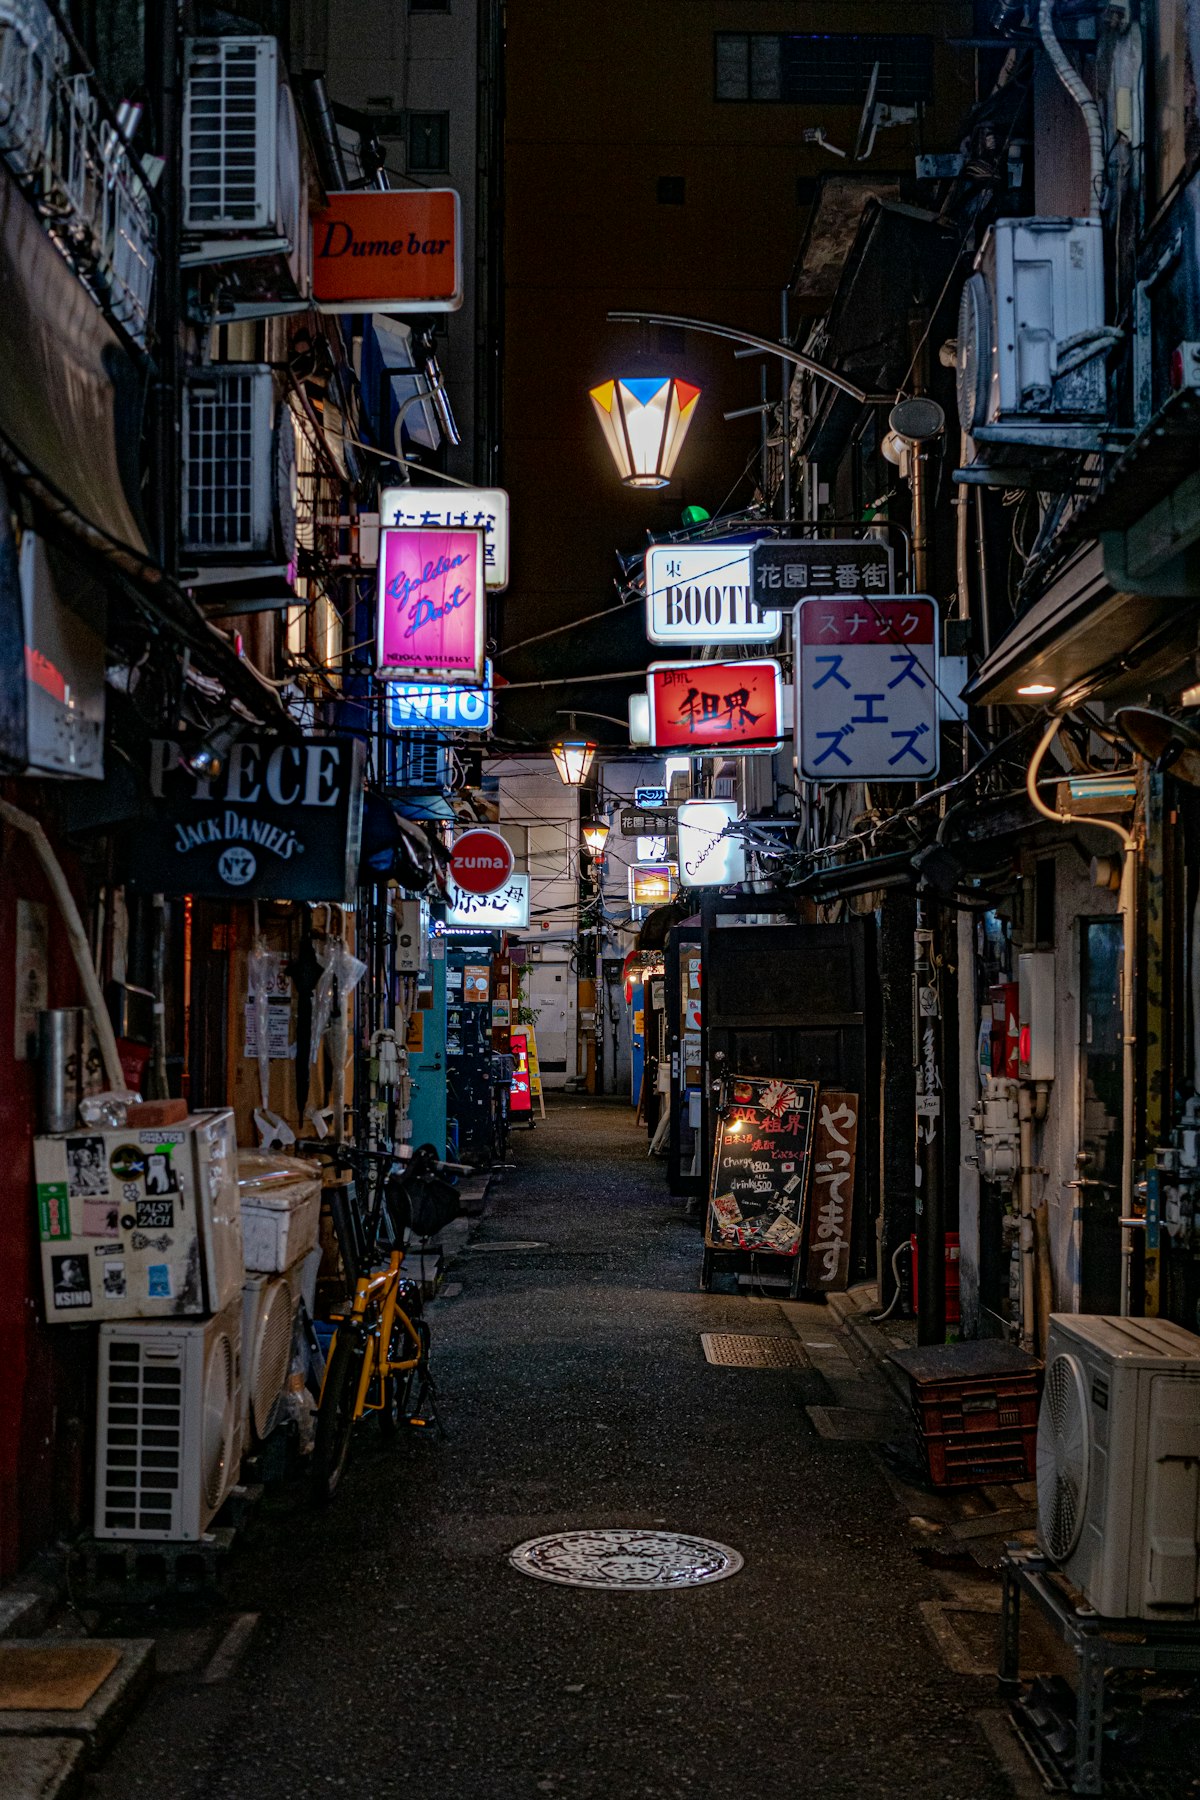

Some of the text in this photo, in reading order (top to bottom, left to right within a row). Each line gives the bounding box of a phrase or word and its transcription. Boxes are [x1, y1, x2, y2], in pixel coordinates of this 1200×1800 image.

[319, 221, 451, 259] Dume bar
[387, 553, 471, 613] Golden
[757, 562, 888, 589] 花園三番街
[403, 584, 472, 639] Dust
[818, 612, 920, 637] スナック
[424, 655, 471, 664] WHISKY
[396, 687, 485, 721] WHO
[453, 856, 509, 869] zuma.
[759, 1113, 805, 1136] 租界
[724, 1133, 753, 1145] 日本酒
[810, 1102, 857, 1281] やってます
[138, 1215, 171, 1227] ZACH
